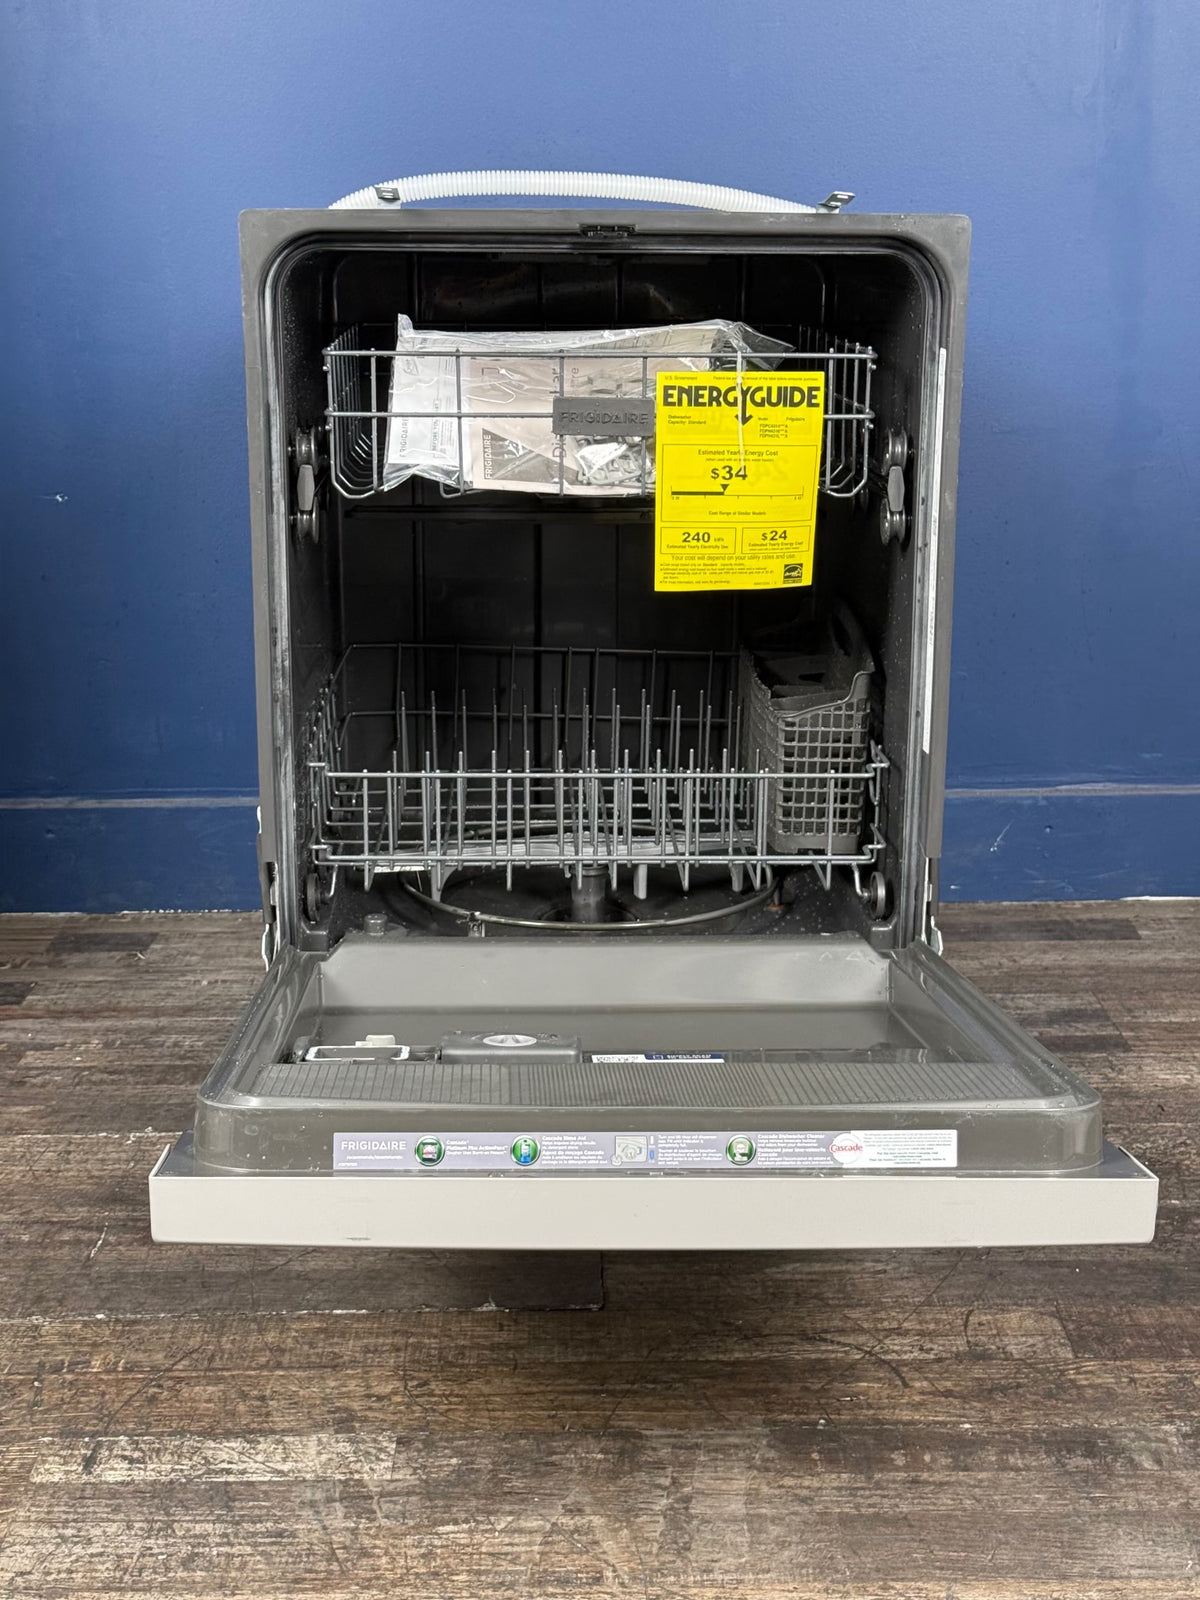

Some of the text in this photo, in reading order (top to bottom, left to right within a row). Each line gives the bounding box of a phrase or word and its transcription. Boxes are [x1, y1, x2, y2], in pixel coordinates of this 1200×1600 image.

[663, 386, 820, 408] ENERGYGUIDE
[560, 411, 649, 424] FRIGIDAIRE
[483, 434, 492, 479] FRIGIDAIRE
[711, 465, 748, 480] $34
[682, 532, 710, 543] 240
[761, 530, 787, 541] $24
[341, 1141, 406, 1151] FRIGIDAIRE
[830, 1144, 863, 1153] Cascade
